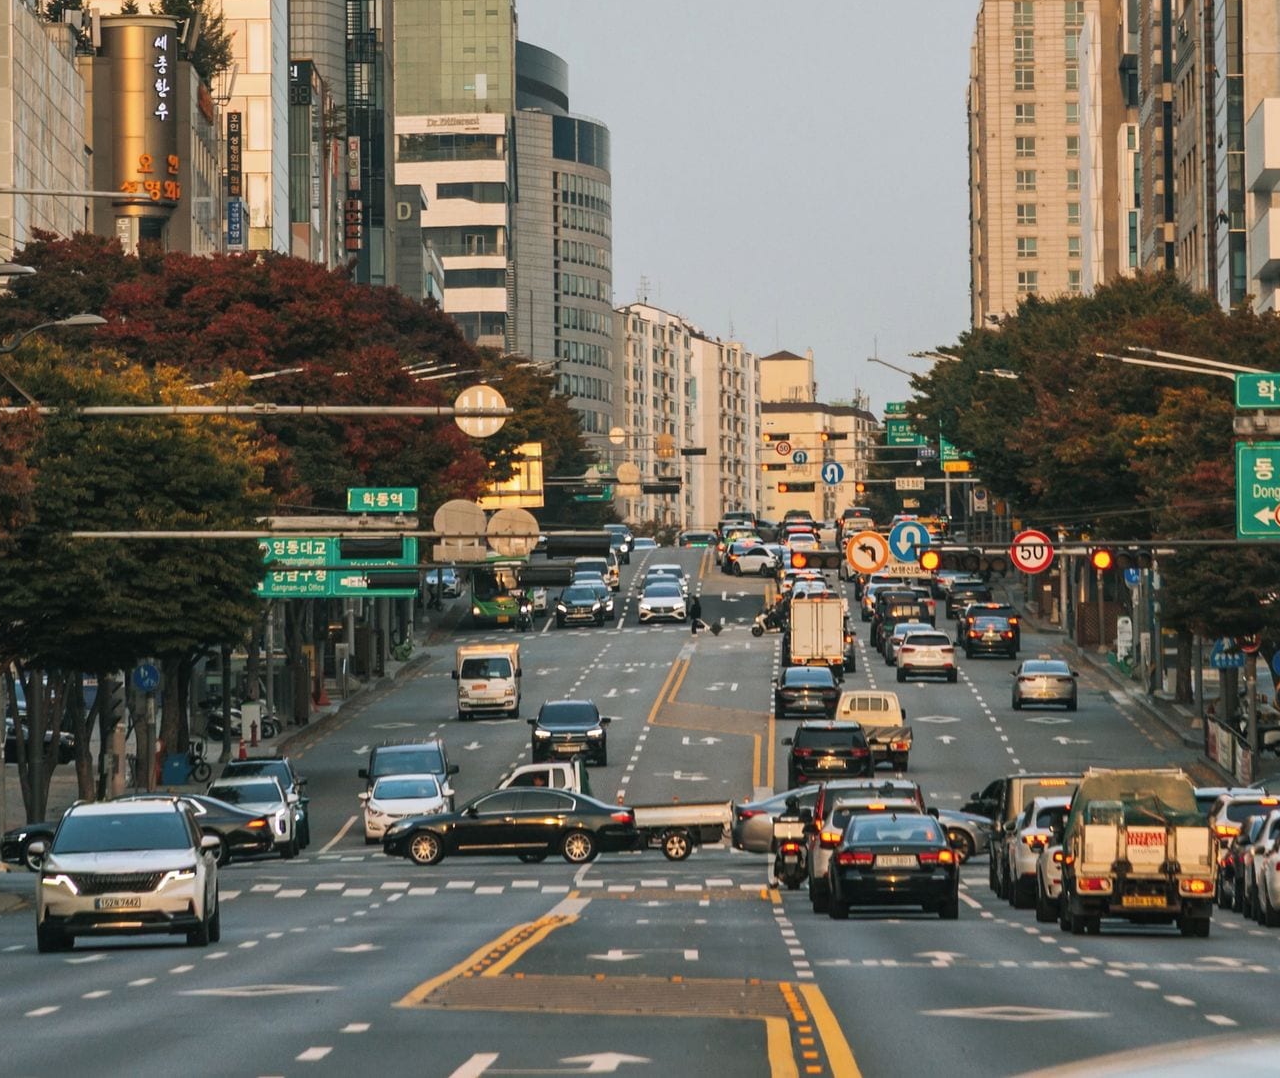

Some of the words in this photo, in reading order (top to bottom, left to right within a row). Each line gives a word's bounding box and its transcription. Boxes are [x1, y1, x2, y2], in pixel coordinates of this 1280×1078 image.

[396, 202, 412, 221] D
[362, 492, 404, 507] 학동역
[272, 540, 327, 556] 영동대교
[1020, 543, 1045, 561] 50
